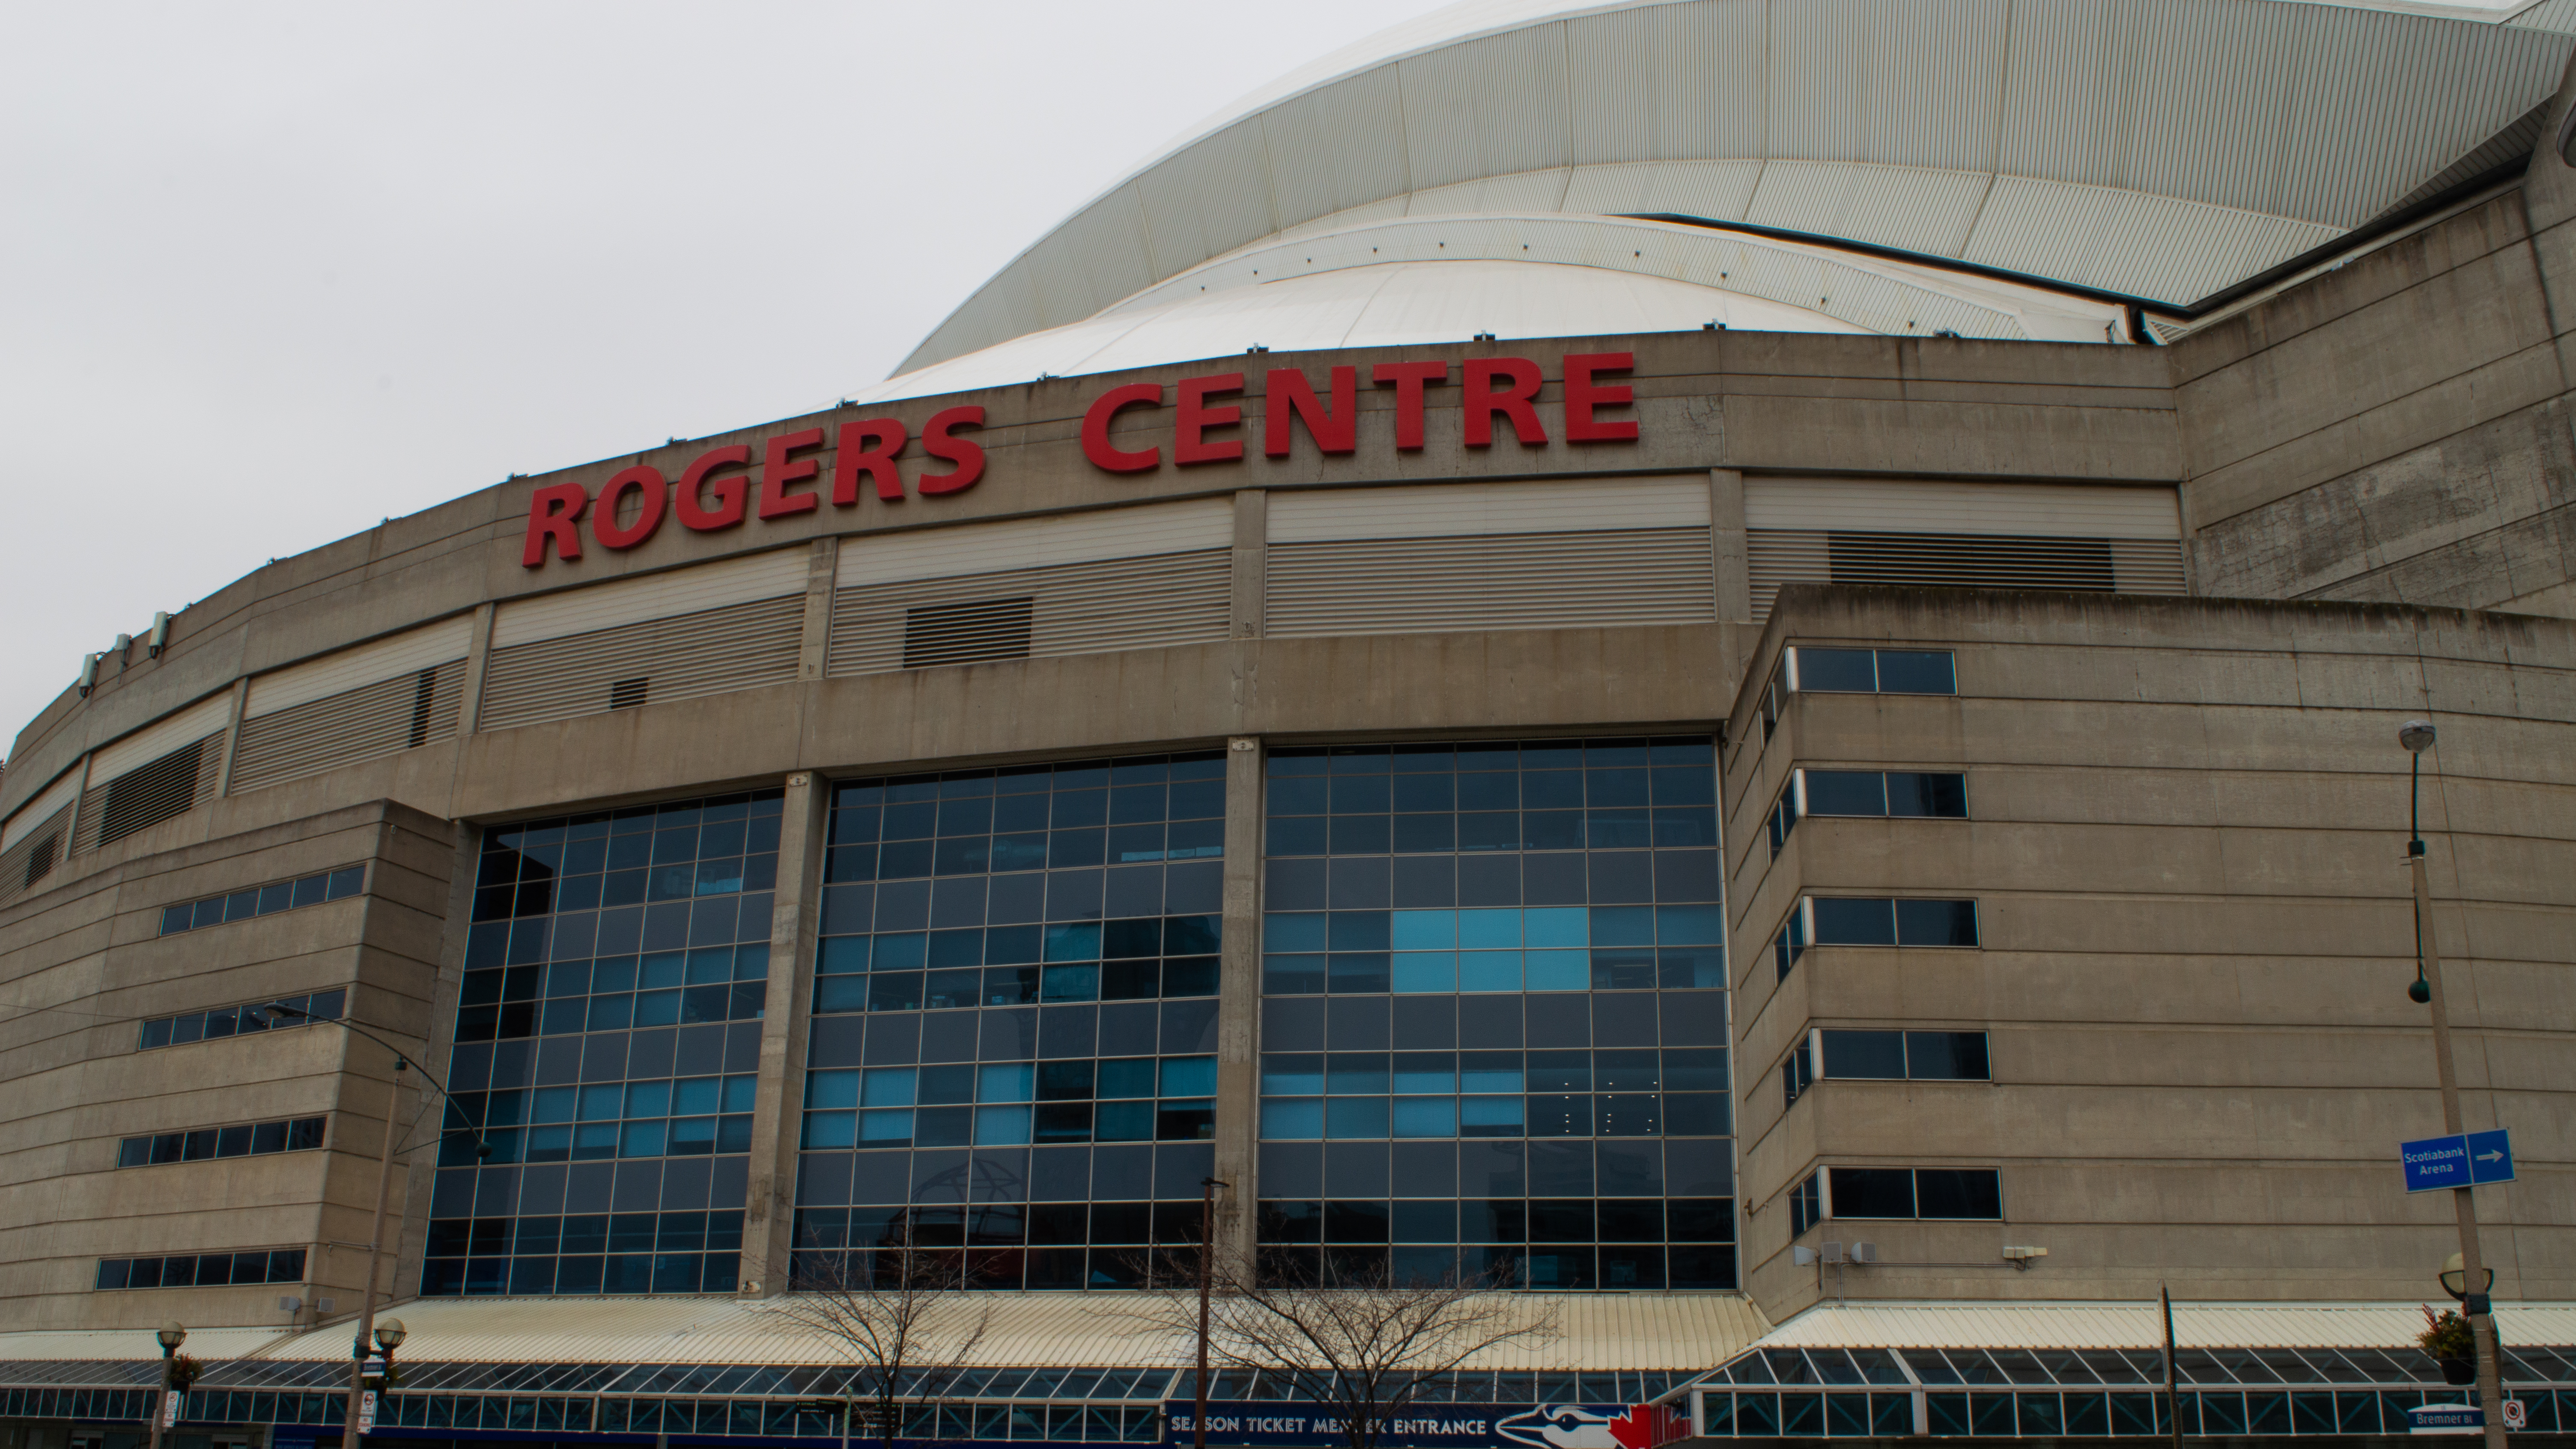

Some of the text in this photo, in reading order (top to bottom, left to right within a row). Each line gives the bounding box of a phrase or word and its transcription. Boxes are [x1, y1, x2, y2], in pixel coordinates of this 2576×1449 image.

[522, 352, 1639, 569] ROGERS CENTRE
[2404, 1147, 2465, 1163] Scotiabank
[2420, 1163, 2454, 1175] Arena
[1246, 1417, 1306, 1433] TICKET
[1312, 1418, 1387, 1434] MEMER
[1393, 1419, 1487, 1434] ENTRANCE
[2416, 1413, 2474, 1425] Bremner Bl
